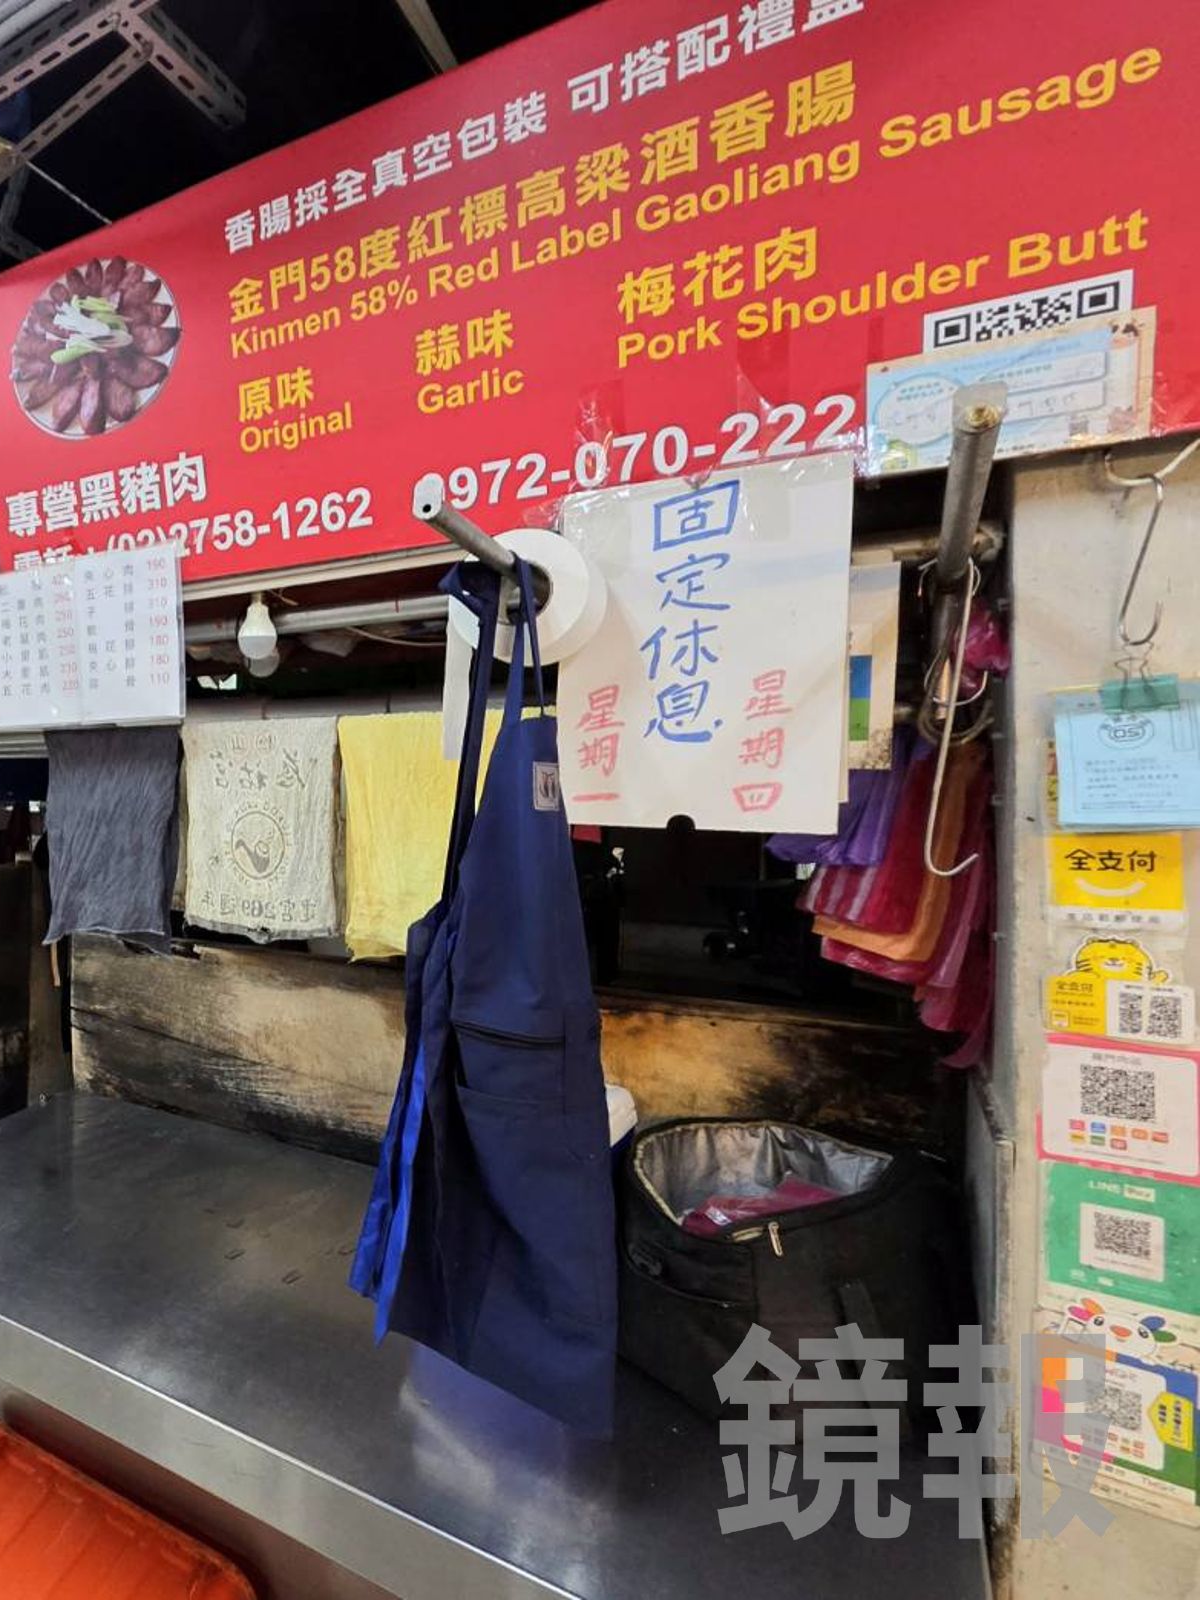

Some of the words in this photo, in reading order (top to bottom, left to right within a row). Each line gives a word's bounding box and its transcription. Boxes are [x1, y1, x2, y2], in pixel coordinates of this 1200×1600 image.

[224, 91, 548, 255] 香腸採全真空包裝
[228, 61, 857, 324] 金門58度紅標高粱酒香腸
[231, 306, 341, 359] Kinmen
[350, 275, 419, 322] 58%
[429, 255, 500, 298] Red
[511, 208, 622, 273] Label
[636, 140, 861, 233] Gaoliang
[879, 47, 1162, 158] Sausage
[617, 227, 818, 325] 梅花肉
[618, 316, 721, 369] Pork
[737, 252, 990, 342] Shoulder
[1007, 208, 1150, 279] Butt
[239, 366, 315, 424] 原味
[416, 309, 514, 377] 蒜味
[417, 367, 526, 414] Garlic
[240, 402, 353, 453] Original
[414, 393, 857, 511] 972-070-222
[5, 452, 208, 539] 專營黑豬肉
[640, 479, 741, 744] 固定休息
[572, 684, 625, 802] 星期一
[732, 669, 793, 813] 星期四
[1064, 849, 1158, 873] 全支付
